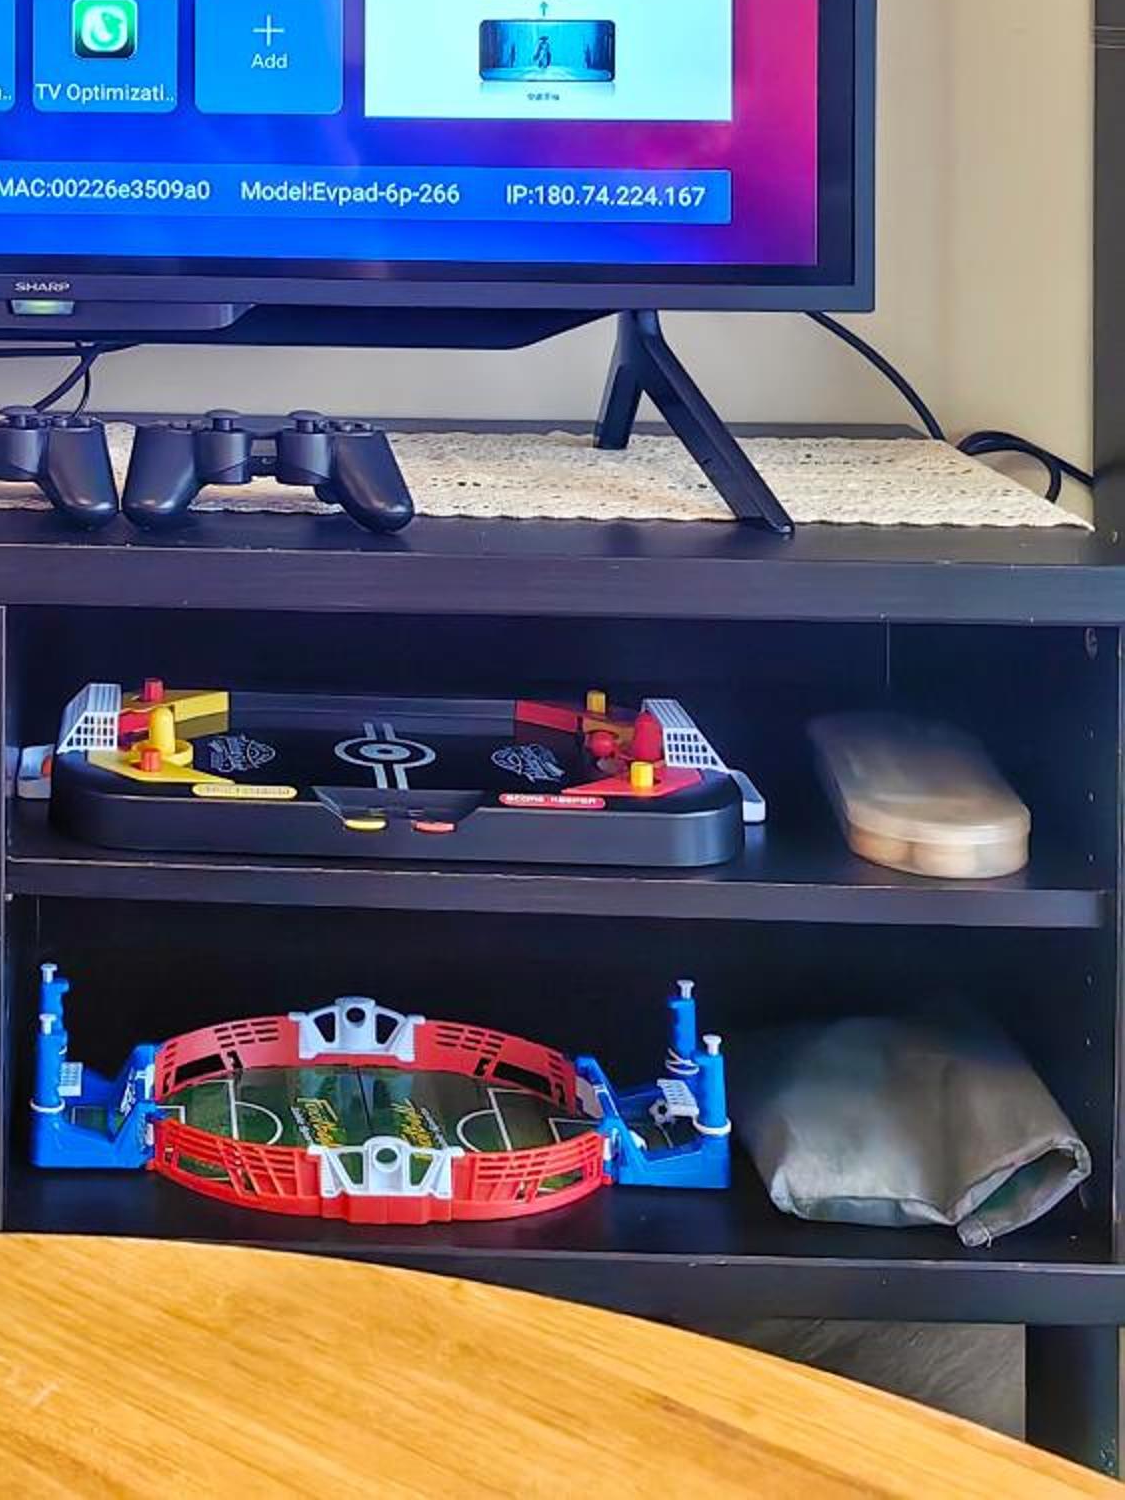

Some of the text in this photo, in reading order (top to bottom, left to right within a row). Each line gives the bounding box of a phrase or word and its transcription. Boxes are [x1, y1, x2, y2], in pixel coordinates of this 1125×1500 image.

[250, 53, 289, 70] Add
[35, 83, 61, 101] TV
[240, 179, 461, 208] Model:Evpad-6p-266
[505, 185, 706, 207] IP:180.74.224.167
[14, 282, 70, 293] SHARP
